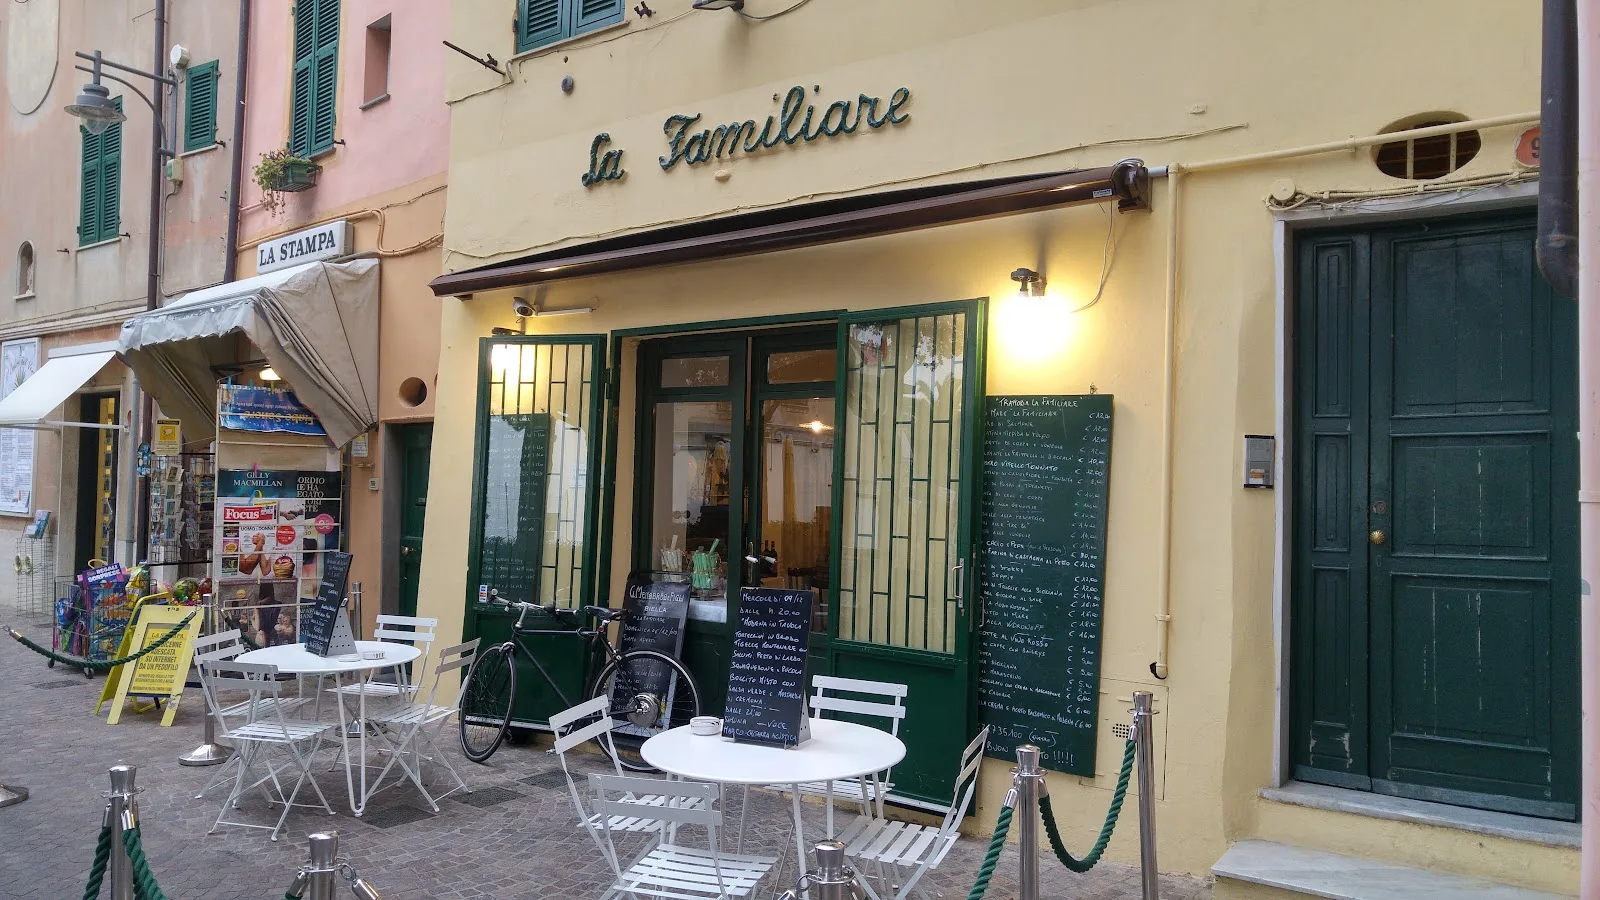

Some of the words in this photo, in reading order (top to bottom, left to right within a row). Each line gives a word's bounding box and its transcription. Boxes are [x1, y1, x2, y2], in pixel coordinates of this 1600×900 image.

[582, 133, 626, 188] La
[658, 84, 912, 171] Familiare
[259, 247, 276, 266] LA
[280, 229, 336, 261] STAMPA
[1001, 460, 1025, 469] VITELLO
[1026, 462, 1059, 472] TONNATO
[233, 479, 282, 488] MACMILLAN
[297, 476, 326, 485] ORDIO
[297, 491, 324, 499] EGATO
[225, 507, 260, 521] Focus
[988, 547, 1007, 557] FARINA
[784, 594, 804, 603] 09/12
[644, 605, 667, 613] BIELLA
[739, 607, 760, 616] DALLE
[775, 633, 800, 643] BRODO
[1028, 637, 1049, 649] ROSSO
[734, 639, 759, 649] TIGELLE
[153, 656, 177, 664] INTERNET
[756, 651, 773, 660] PESTO
[781, 665, 802, 675] RUCOLA
[730, 673, 757, 683] BOLLITO
[760, 675, 777, 686] MISTO
[728, 685, 745, 693] SALSA
[748, 687, 766, 697] VERDE
[725, 705, 742, 715] DALLE
[1012, 705, 1027, 715] ACETO
[724, 715, 747, 725] SIMONA
[768, 719, 788, 730] VOCE
[986, 740, 1010, 754] BUON
